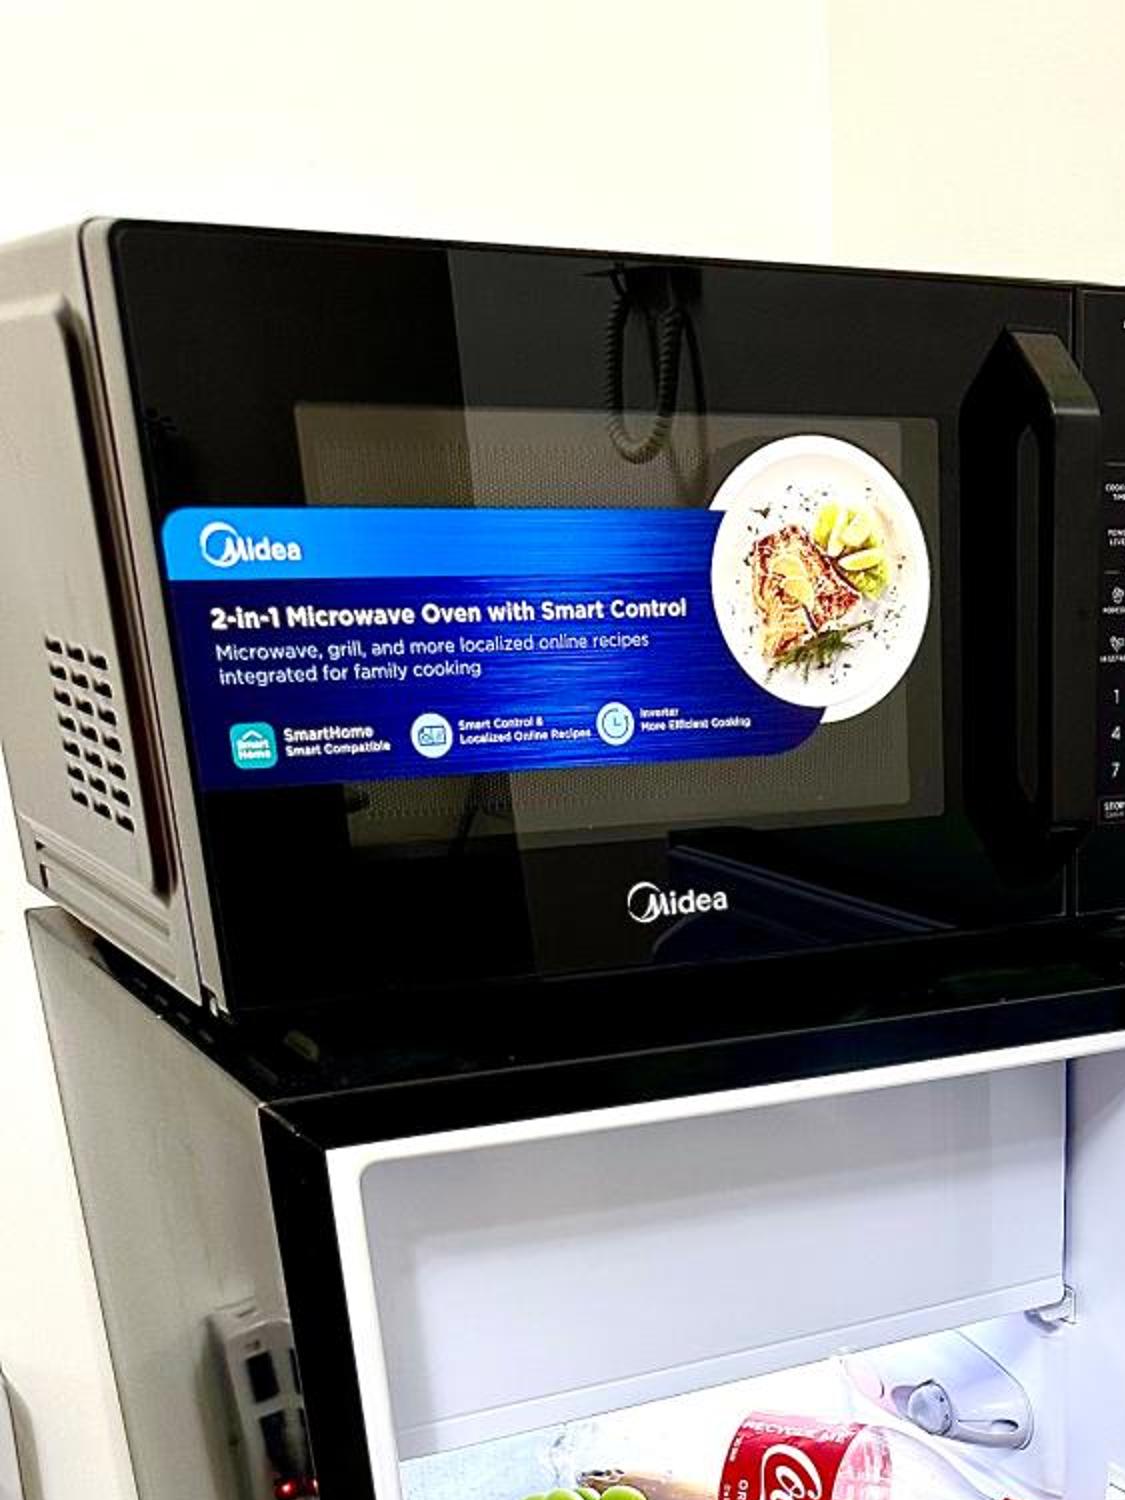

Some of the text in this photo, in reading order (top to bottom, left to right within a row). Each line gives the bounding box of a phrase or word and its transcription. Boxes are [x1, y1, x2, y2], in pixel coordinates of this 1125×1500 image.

[200, 521, 302, 568] Midea
[210, 597, 687, 630] 2-in-1 Microwave Oven with Smart Control
[215, 631, 650, 661] Microwave, grill, and more localized online recipes
[219, 659, 482, 687] integrated for family cooking
[1113, 689, 1120, 704] 1
[458, 719, 491, 731] Smart
[493, 716, 534, 729] Control
[283, 726, 374, 742] SmartHome
[459, 731, 513, 745] Localized
[513, 730, 549, 743] Online
[1111, 725, 1121, 741] 4
[285, 740, 391, 757] Smart Compatible
[1111, 761, 1121, 779] 7
[627, 881, 728, 923] Midea
